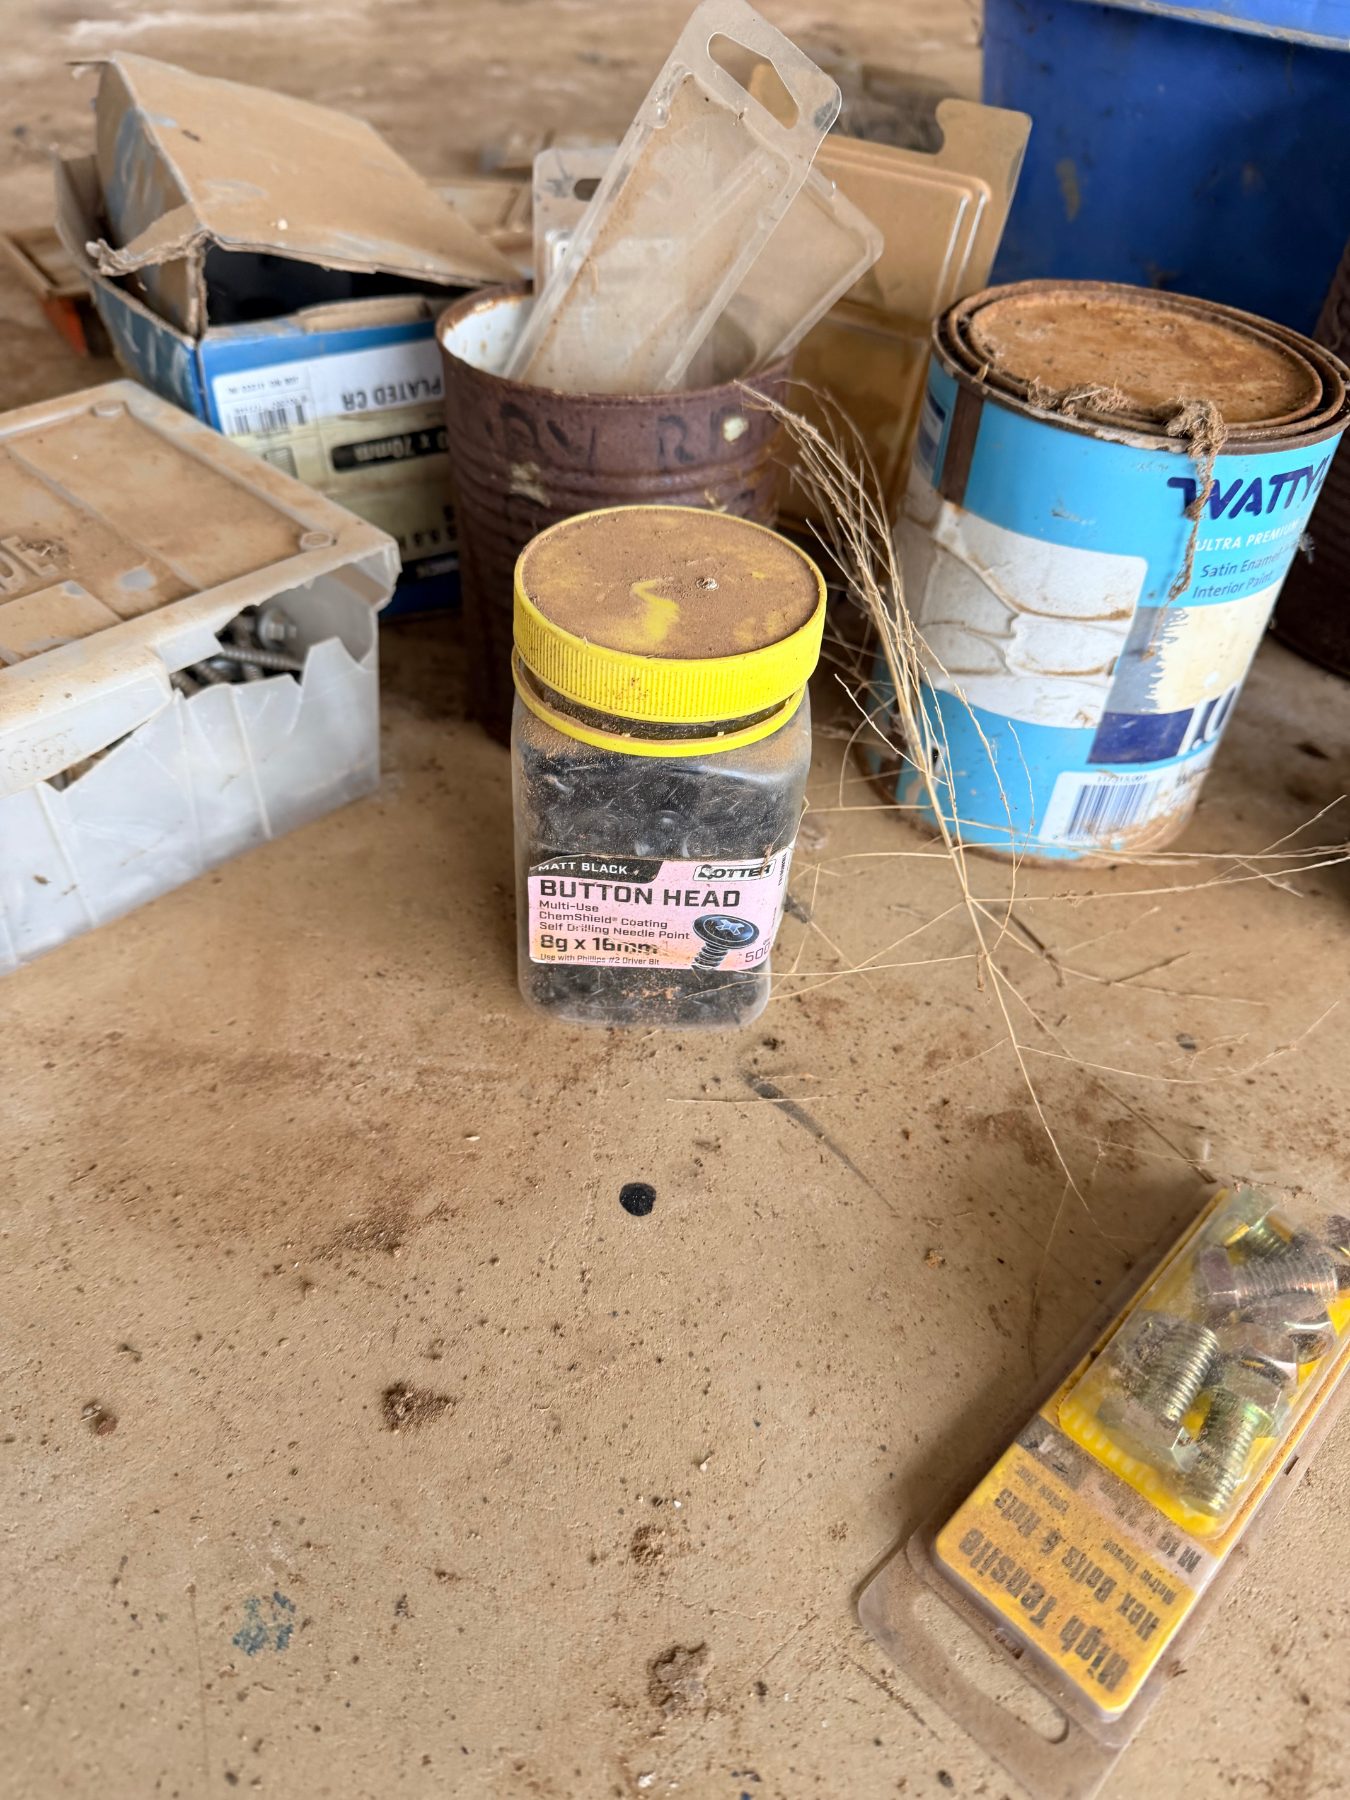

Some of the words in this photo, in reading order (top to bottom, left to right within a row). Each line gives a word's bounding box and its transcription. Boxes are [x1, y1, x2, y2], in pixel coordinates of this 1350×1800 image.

[1195, 536, 1242, 552] ULTRA
[1200, 563, 1238, 578] Satin
[1192, 581, 1243, 598] Interior
[538, 861, 576, 872] MATT
[581, 862, 628, 875] BLACK
[540, 879, 653, 905] BUTTON
[663, 889, 741, 907] HEAD
[539, 900, 599, 912] Multi-Use
[539, 921, 563, 931] Self
[567, 923, 609, 936] Drilling
[613, 927, 655, 938] Needle
[659, 930, 690, 940] Point
[621, 917, 668, 929] Coating
[540, 934, 568, 952] 8g
[574, 939, 586, 950] x
[540, 953, 556, 961] Use
[558, 953, 575, 961] with
[958, 1527, 1058, 1630] Tensile
[1060, 1546, 1118, 1603] Bolts
[1117, 1592, 1161, 1642] Hex
[1059, 1614, 1130, 1694] High
